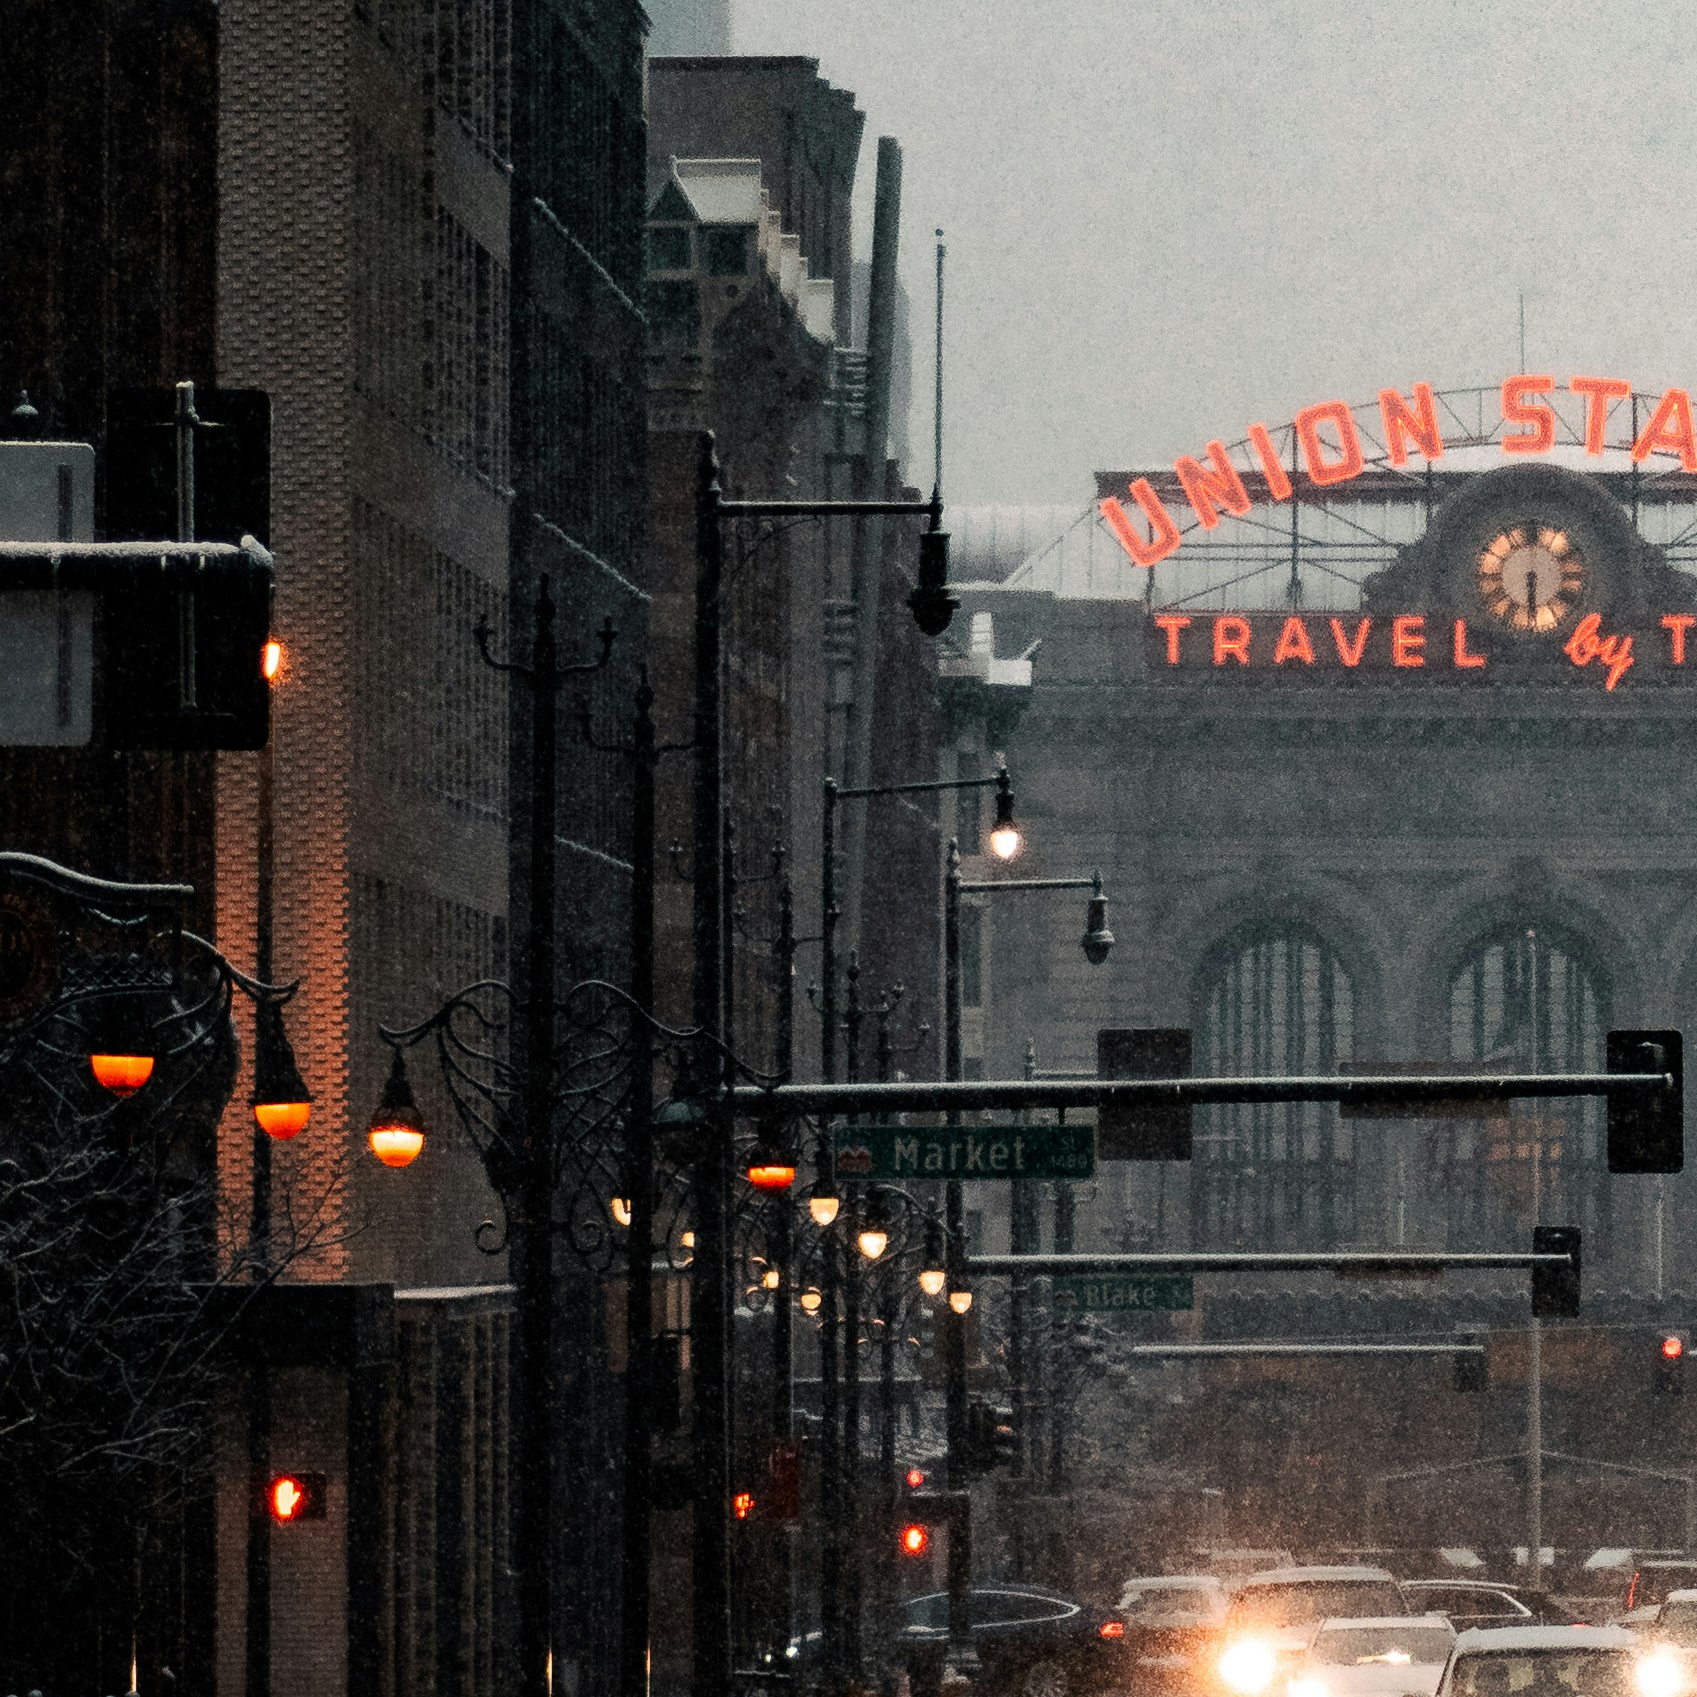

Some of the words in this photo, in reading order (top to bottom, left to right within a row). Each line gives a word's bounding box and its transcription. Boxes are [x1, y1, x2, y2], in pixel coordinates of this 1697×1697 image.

[1100, 382, 1445, 568] UNION
[1154, 614, 1488, 668] TRAVEL
[1562, 612, 1636, 692] by
[893, 1135, 1026, 1171] Market
[1085, 1282, 1156, 1307] Blake
